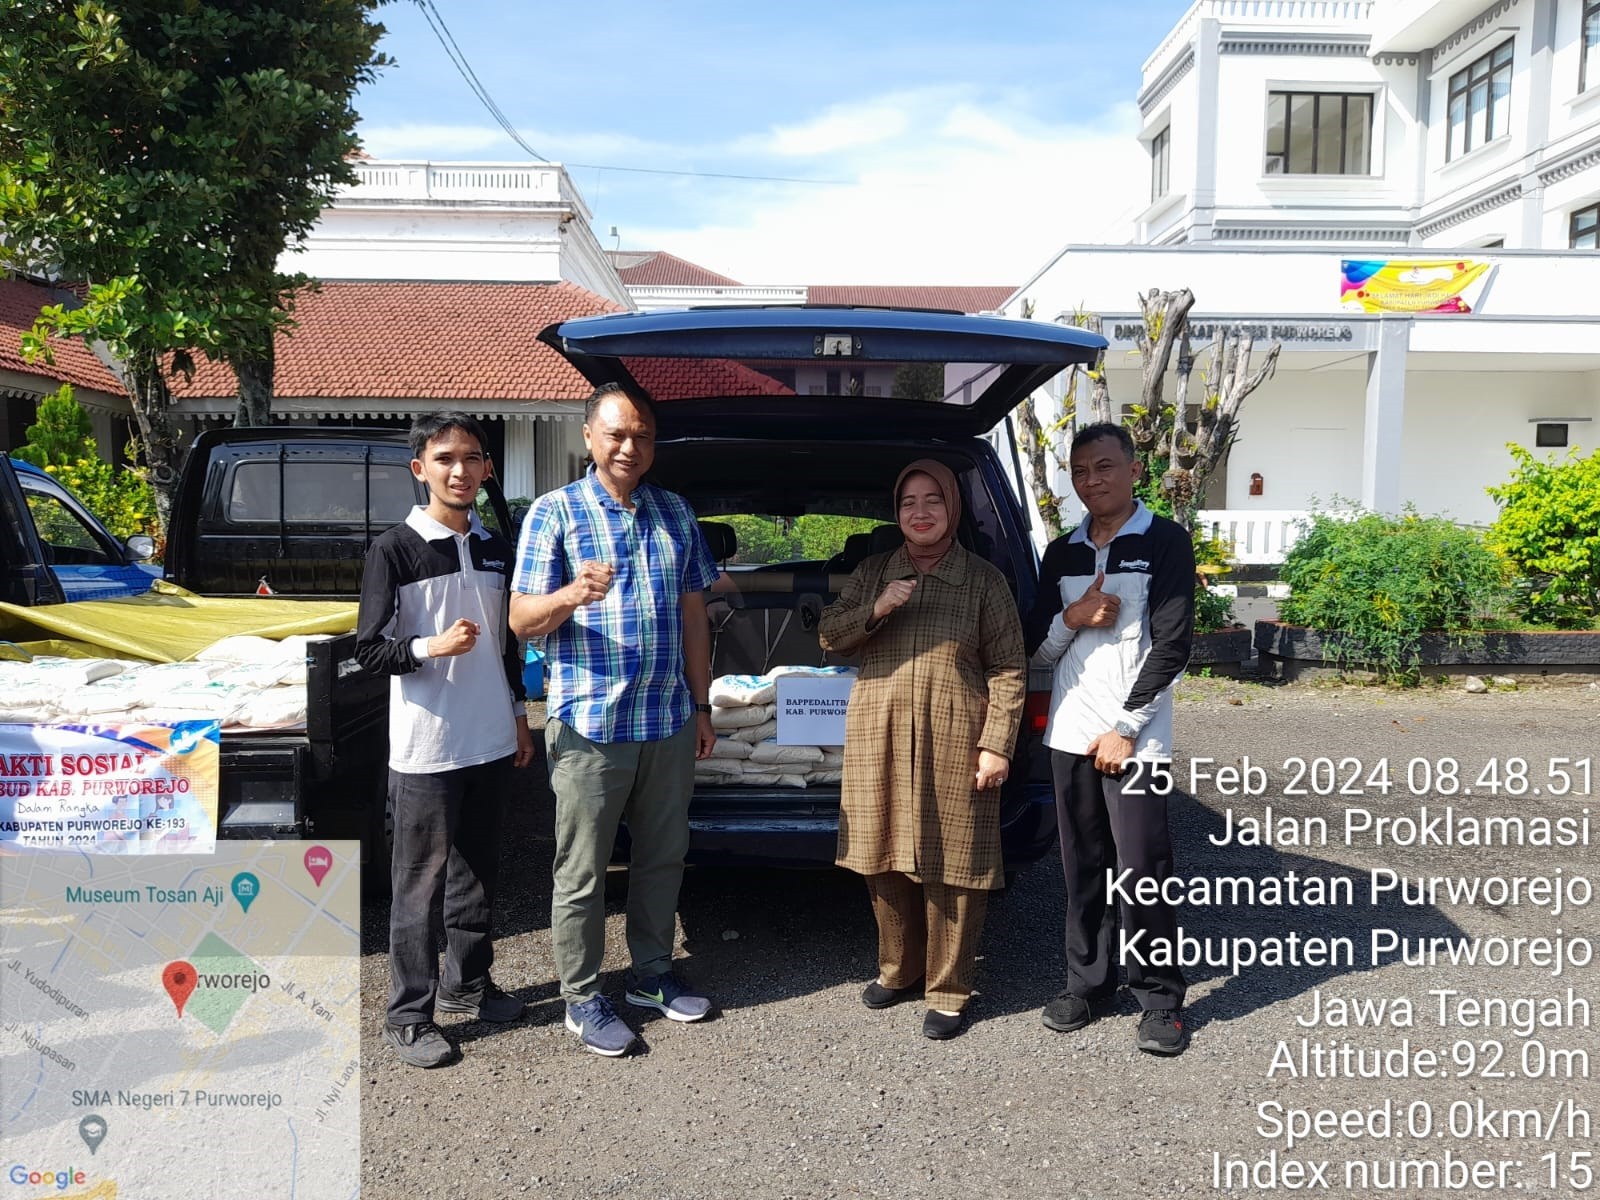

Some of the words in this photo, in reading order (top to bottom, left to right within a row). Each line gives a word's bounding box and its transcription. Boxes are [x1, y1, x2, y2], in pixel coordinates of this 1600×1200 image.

[785, 698, 849, 706] BAPPEDALITB
[785, 708, 807, 716] KAB.
[809, 708, 847, 716] PURWOR
[0, 753, 55, 777] AKTI
[61, 752, 147, 776] SOSIAL
[36, 780, 75, 797] KAB.
[82, 777, 190, 797] PURWOREJO
[18, 802, 52, 814] Dalam
[59, 799, 100, 818] Rangka
[67, 819, 143, 831] PURWOREJO
[146, 818, 186, 831] KE-193
[23, 835, 64, 847] TAHUN
[68, 835, 97, 846] 2024
